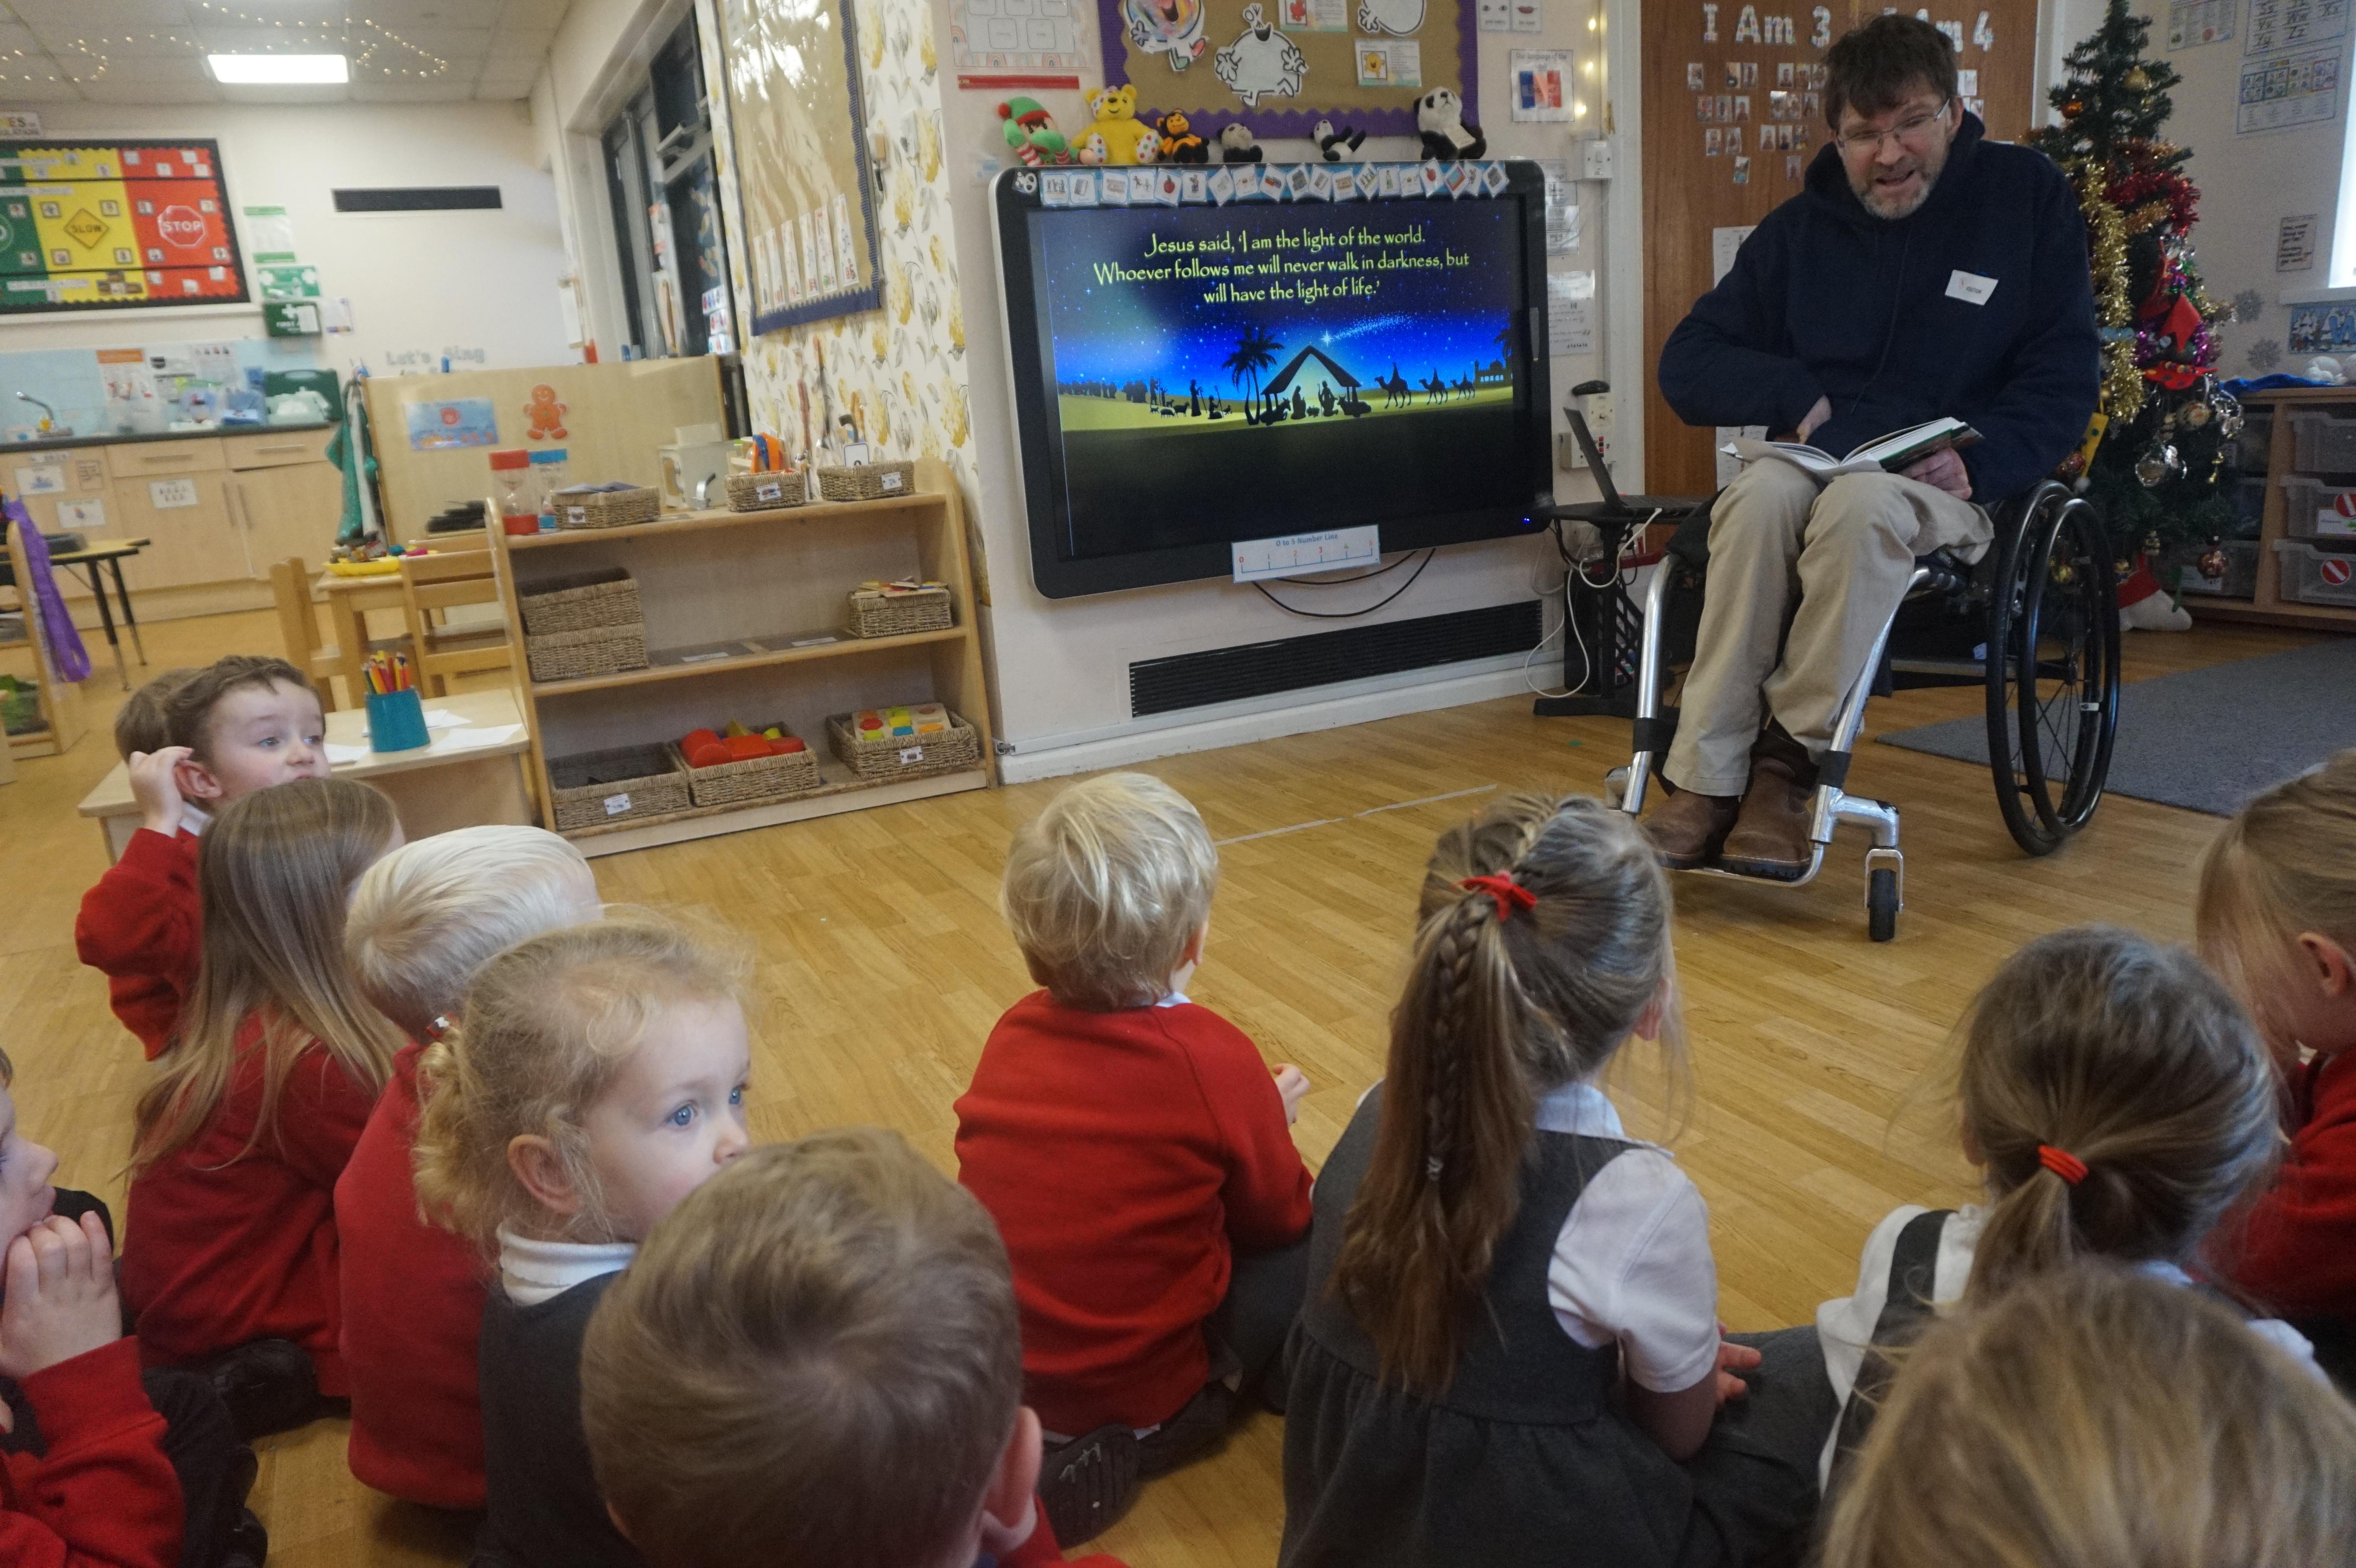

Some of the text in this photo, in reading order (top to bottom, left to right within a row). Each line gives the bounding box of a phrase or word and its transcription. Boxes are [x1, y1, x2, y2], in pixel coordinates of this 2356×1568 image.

[1703, 3, 1831, 47] I Am 3
[1973, 10, 1993, 52] 4
[162, 220, 203, 232] STOP
[1144, 233, 1194, 257] Jesus
[1199, 230, 1235, 253] said,
[1251, 238, 1272, 249] am
[1276, 229, 1300, 248] the
[1303, 227, 1335, 253] light
[1339, 226, 1355, 246] of
[1358, 227, 1381, 245] the
[1384, 224, 1425, 244] world.
[1093, 247, 1469, 285] Whoever follows me will never walk in darkness, but
[1204, 276, 1380, 304] will have the light of life.’
[1297, 535, 1323, 544] Number
